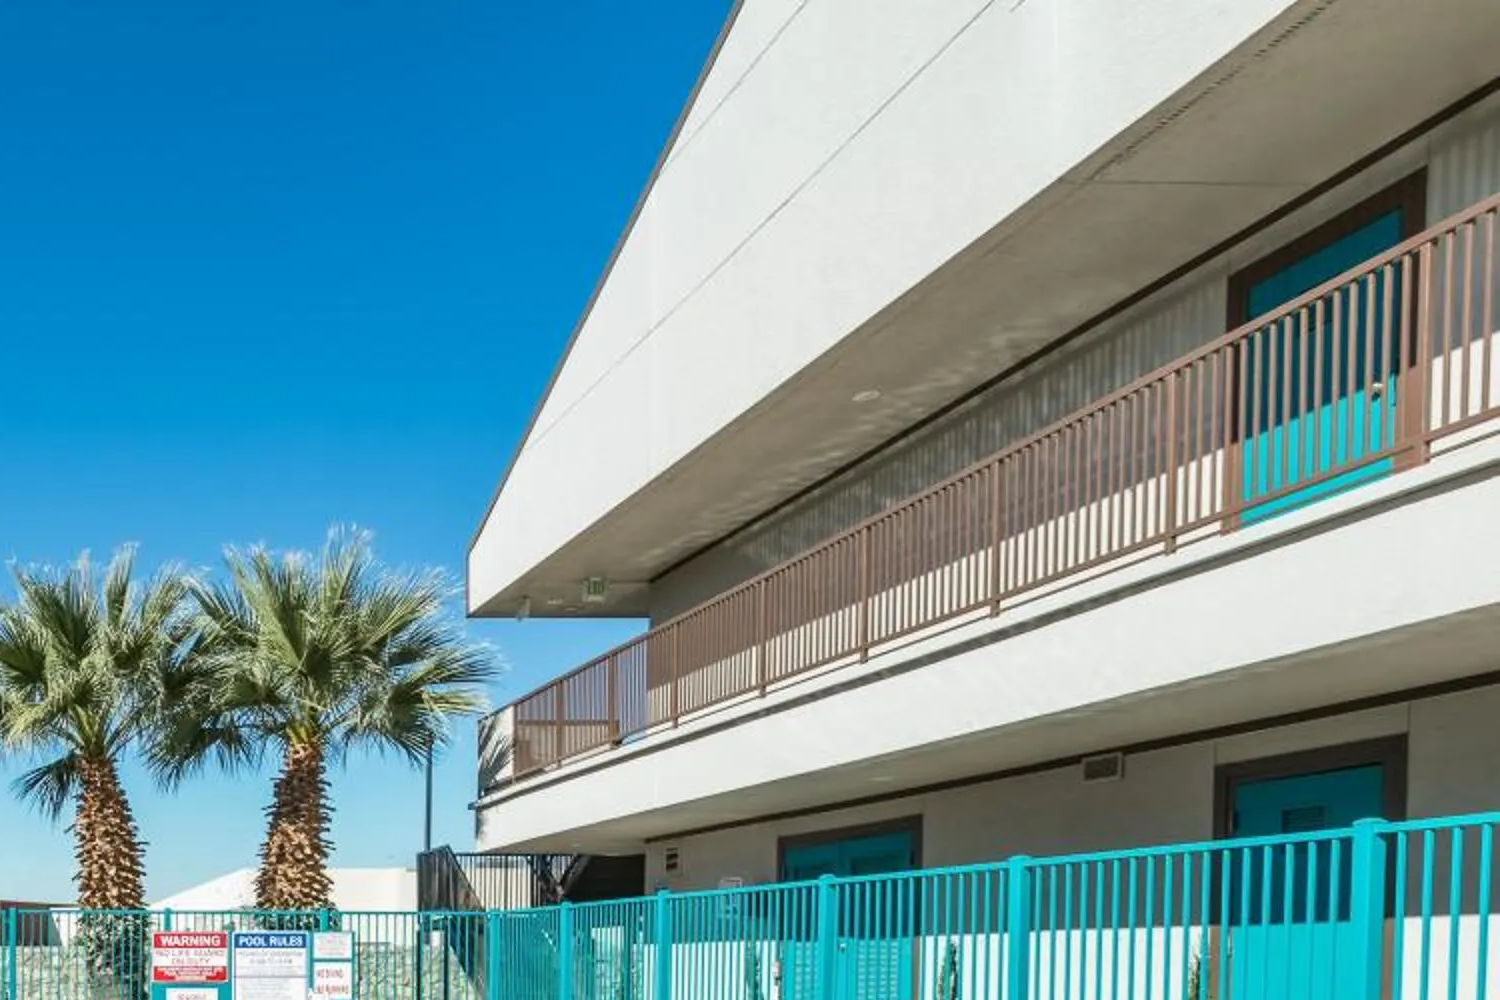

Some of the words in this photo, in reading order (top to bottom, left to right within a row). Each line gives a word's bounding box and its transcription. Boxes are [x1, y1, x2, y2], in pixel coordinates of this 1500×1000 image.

[160, 935, 221, 947] WARNING
[239, 935, 267, 947] POOL
[269, 935, 303, 947] RULES
